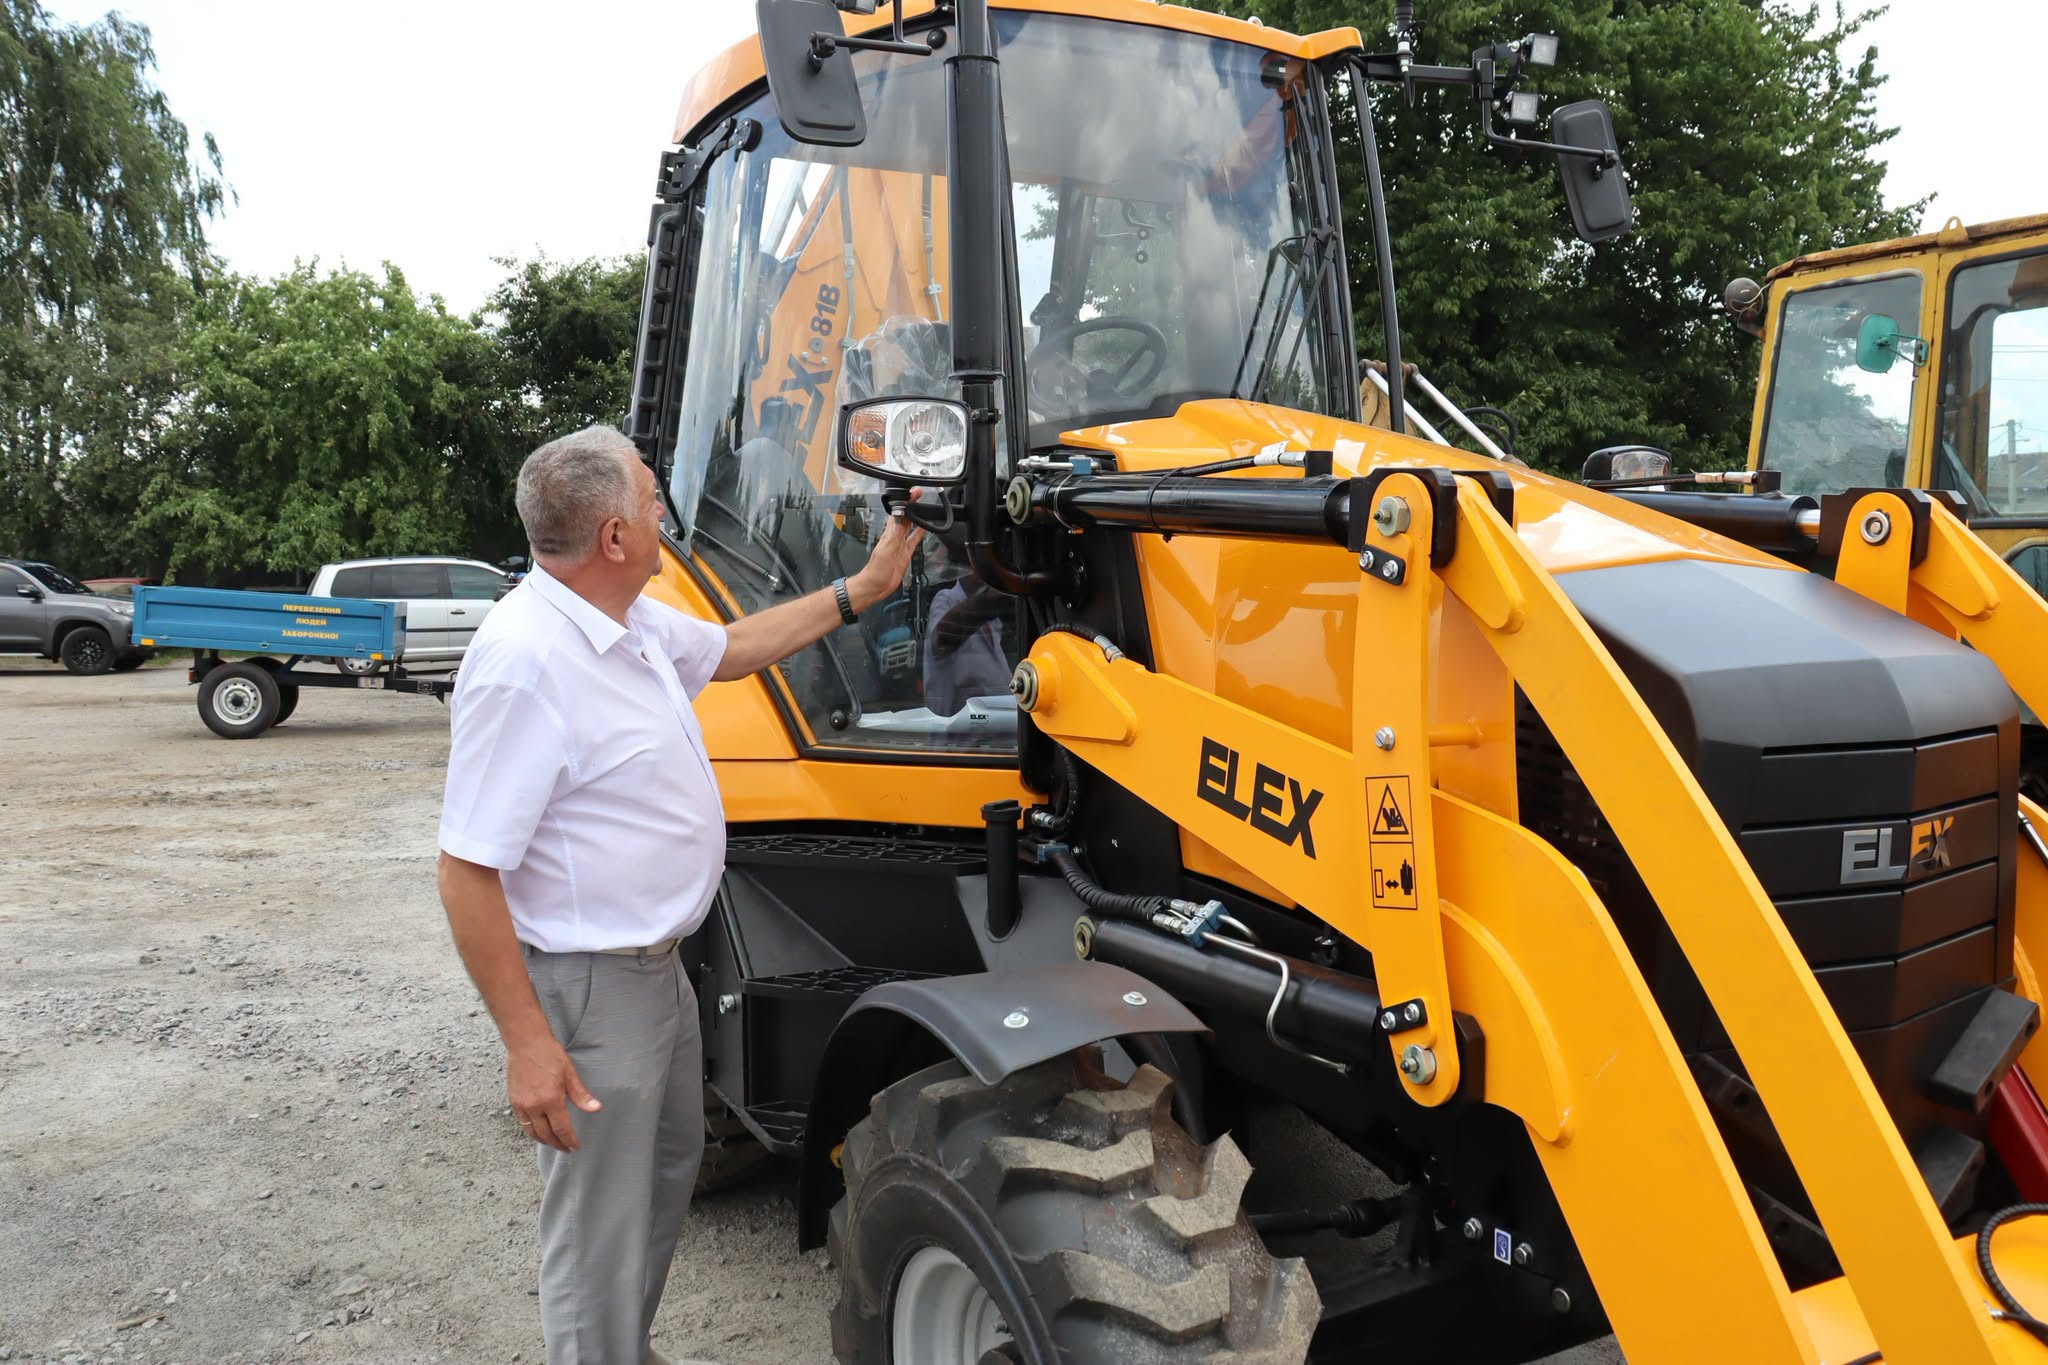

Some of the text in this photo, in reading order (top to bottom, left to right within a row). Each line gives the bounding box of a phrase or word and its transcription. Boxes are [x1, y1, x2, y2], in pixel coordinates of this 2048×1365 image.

[810, 283, 841, 337] 81B
[283, 604, 342, 614] ПЕРЕВЕЗЕННЯ
[296, 617, 327, 626] ЛЮДЕЙ
[282, 630, 339, 640] ЗАБОРОНЕНО!
[1197, 736, 1324, 860] ELEX
[1840, 816, 1954, 885] ELEX
